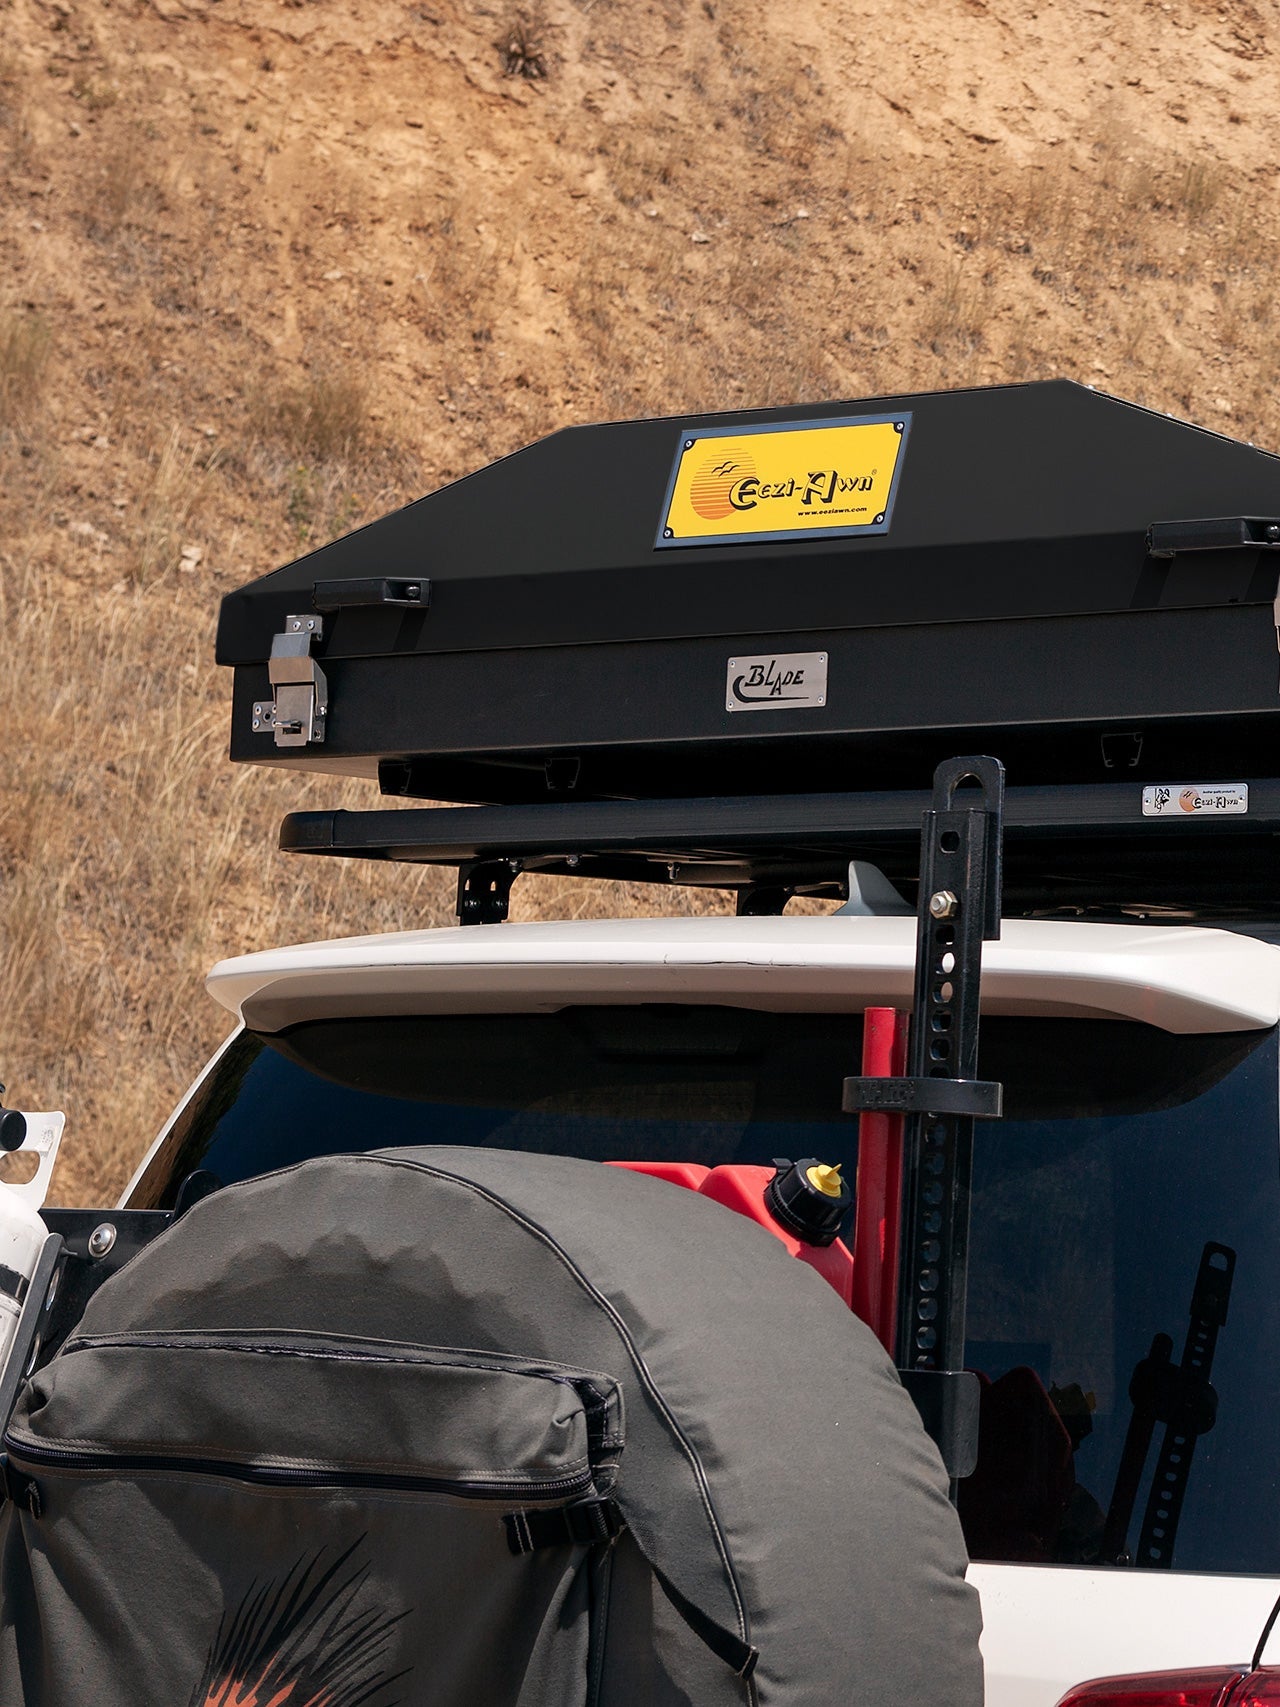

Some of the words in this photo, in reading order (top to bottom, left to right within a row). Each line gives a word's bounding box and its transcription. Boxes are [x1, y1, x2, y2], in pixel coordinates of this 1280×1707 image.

[729, 470, 873, 511] Eezi-Awn
[797, 506, 868, 517] www.eeziawn.com
[744, 660, 805, 696] BLADE
